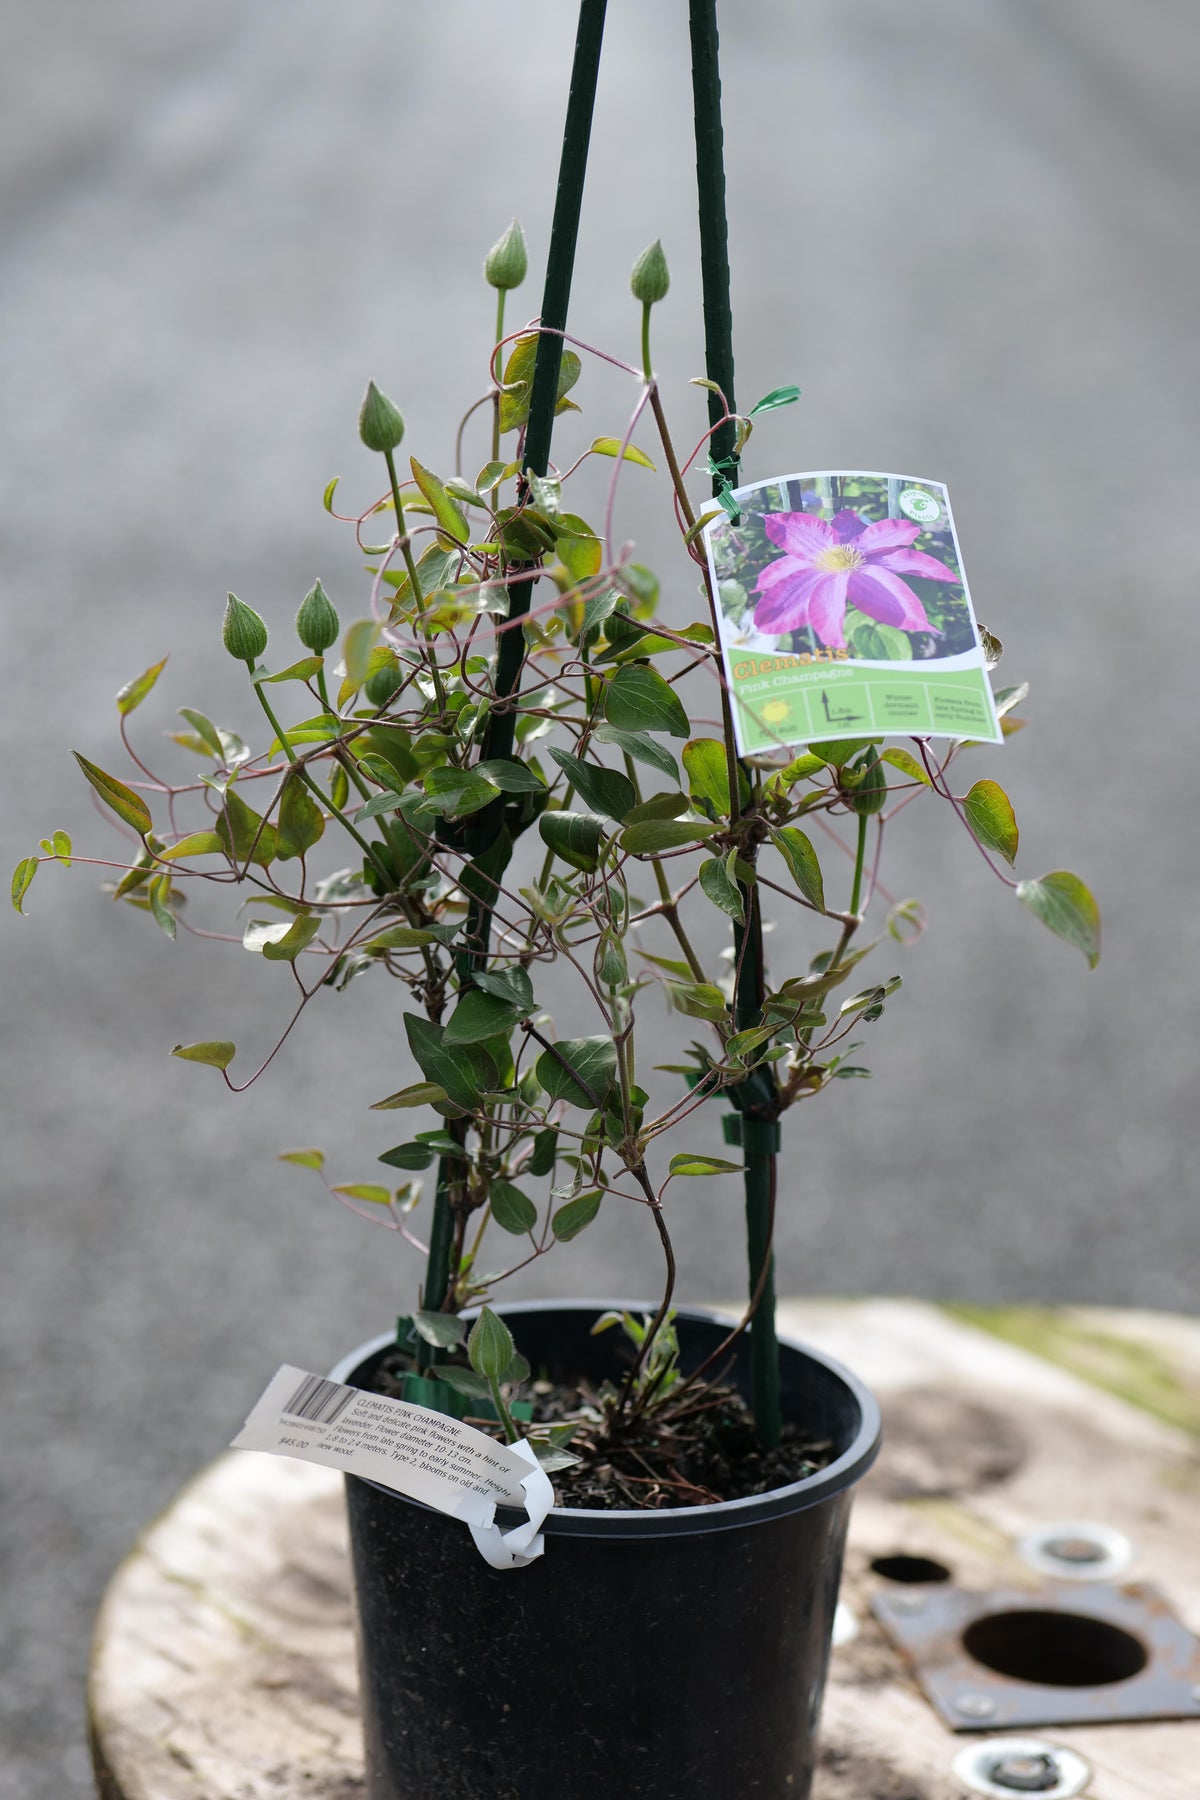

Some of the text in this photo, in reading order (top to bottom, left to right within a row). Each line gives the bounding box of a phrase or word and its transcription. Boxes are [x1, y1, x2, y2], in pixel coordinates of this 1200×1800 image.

[733, 645, 849, 680] Clematis
[342, 1416, 372, 1429] lavender.
[375, 1424, 400, 1436] Flower
[399, 1432, 434, 1449] diameter
[434, 1444, 459, 1458] 10-13
[357, 1399, 462, 1437] CLEMATIS PINK CHAMPAGNE
[278, 1437, 309, 1449] $45.00
[316, 1442, 355, 1457] new wood.
[333, 1425, 361, 1437] Flowers
[361, 1431, 379, 1442] from
[380, 1437, 395, 1446] late
[394, 1442, 419, 1456] spring
[419, 1449, 429, 1458] to
[428, 1454, 449, 1467] early
[449, 1463, 482, 1481] summer.
[484, 1478, 512, 1497] Height
[352, 1408, 368, 1418] Soft
[367, 1413, 384, 1421] and
[382, 1416, 411, 1429] delicate
[410, 1425, 429, 1435] pink
[428, 1430, 457, 1446] flowers
[457, 1443, 475, 1455] with
[482, 1454, 500, 1468] hint
[499, 1466, 511, 1474] of
[325, 1433, 339, 1442] 1.8
[338, 1436, 348, 1444] to
[360, 1442, 388, 1456] meters.
[390, 1450, 410, 1464] Type
[409, 1457, 417, 1467] 2,
[419, 1461, 448, 1478] blooms
[447, 1474, 459, 1483] on
[460, 1479, 474, 1488] old
[472, 1485, 490, 1496] and
